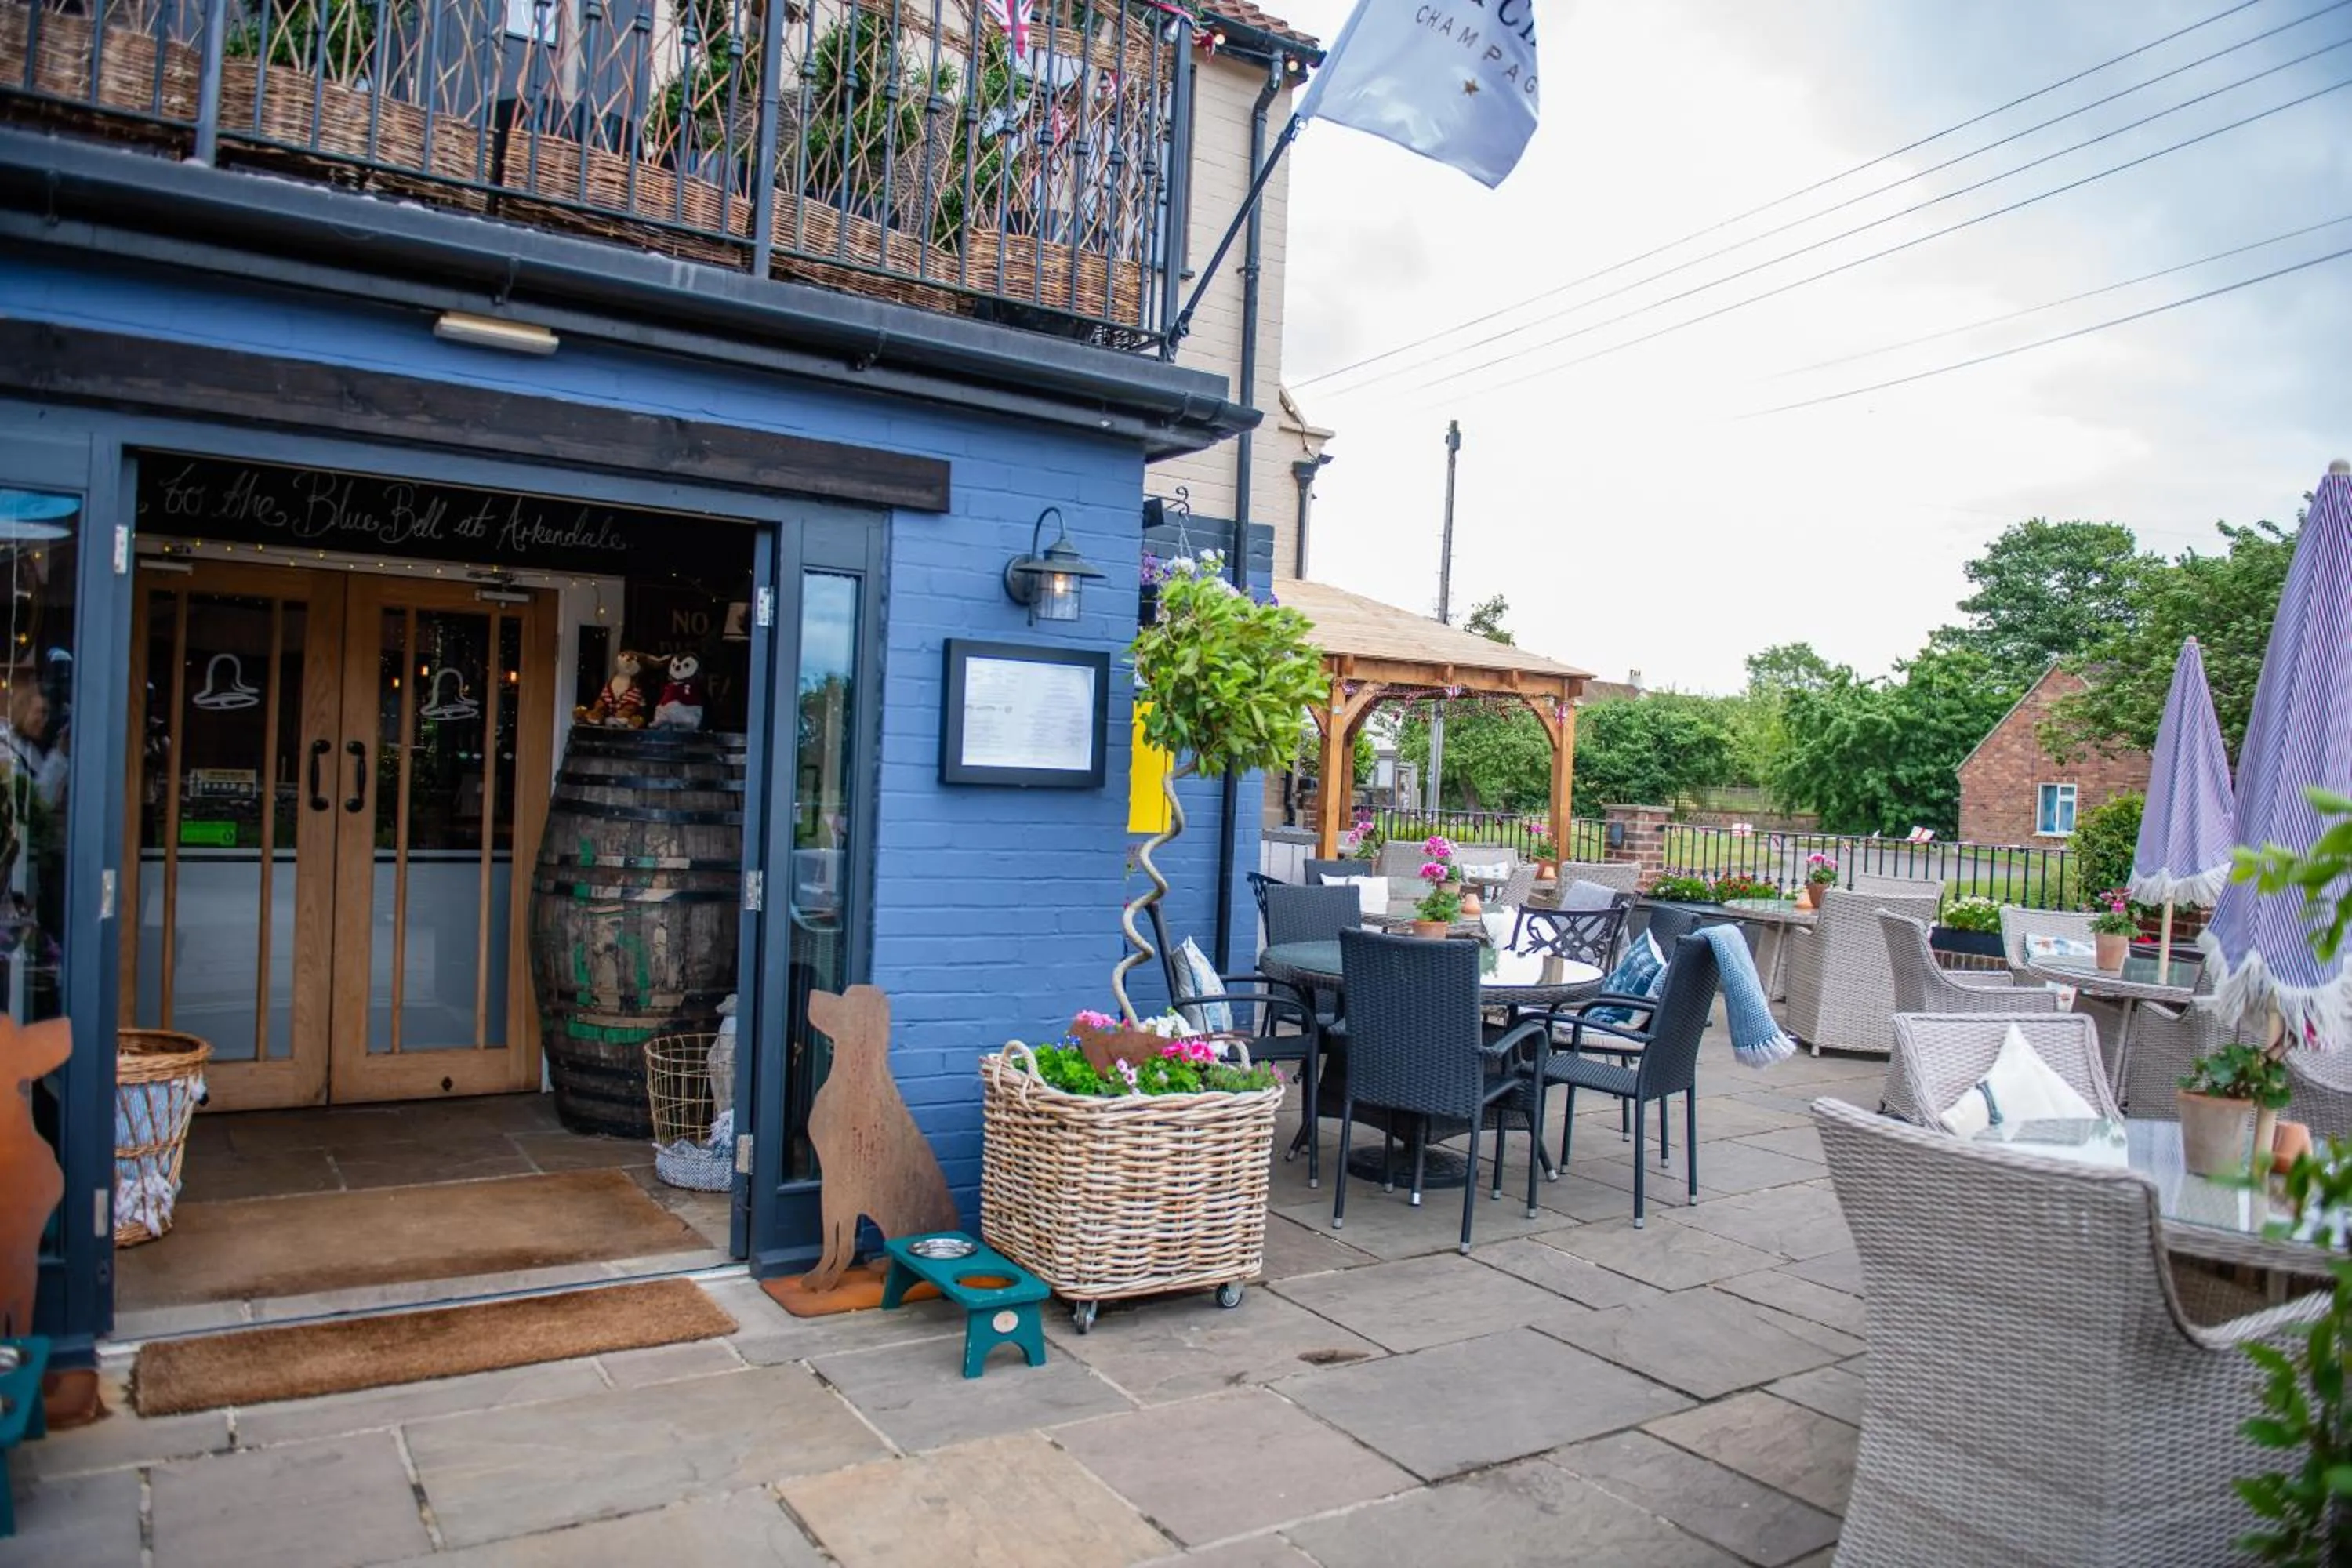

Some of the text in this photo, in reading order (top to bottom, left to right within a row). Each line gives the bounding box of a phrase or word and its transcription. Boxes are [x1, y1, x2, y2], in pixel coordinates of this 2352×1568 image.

[159, 463, 627, 553] to the Blue Bell at Arkendale
[671, 608, 710, 636] NO
